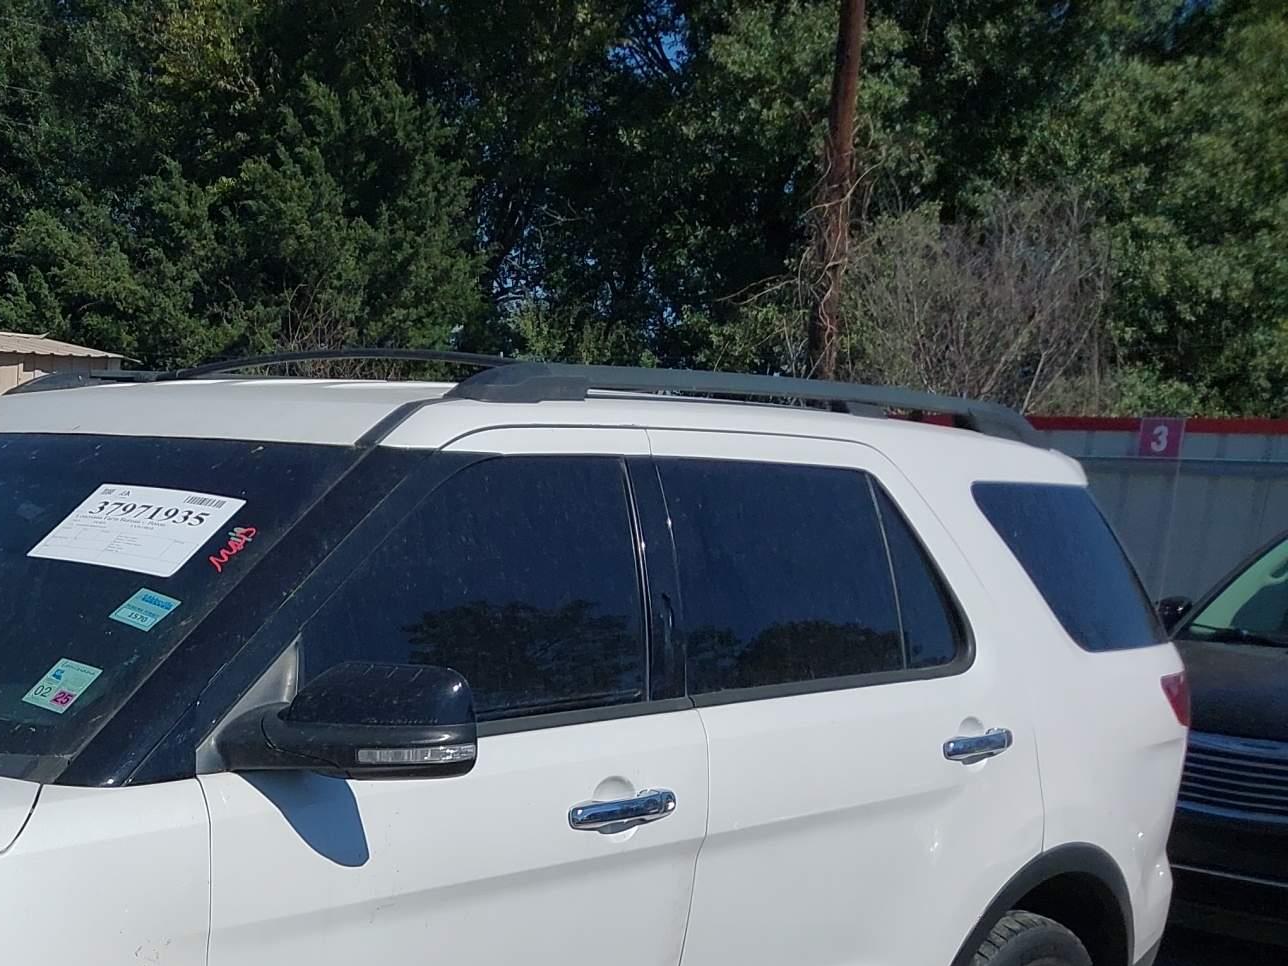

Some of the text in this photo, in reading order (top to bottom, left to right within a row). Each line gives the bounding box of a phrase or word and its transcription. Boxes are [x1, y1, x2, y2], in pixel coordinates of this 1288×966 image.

[1150, 425, 1169, 452] 3
[88, 501, 211, 526] 37971935
[127, 612, 149, 623] 1570
[33, 685, 73, 705] 02 25
